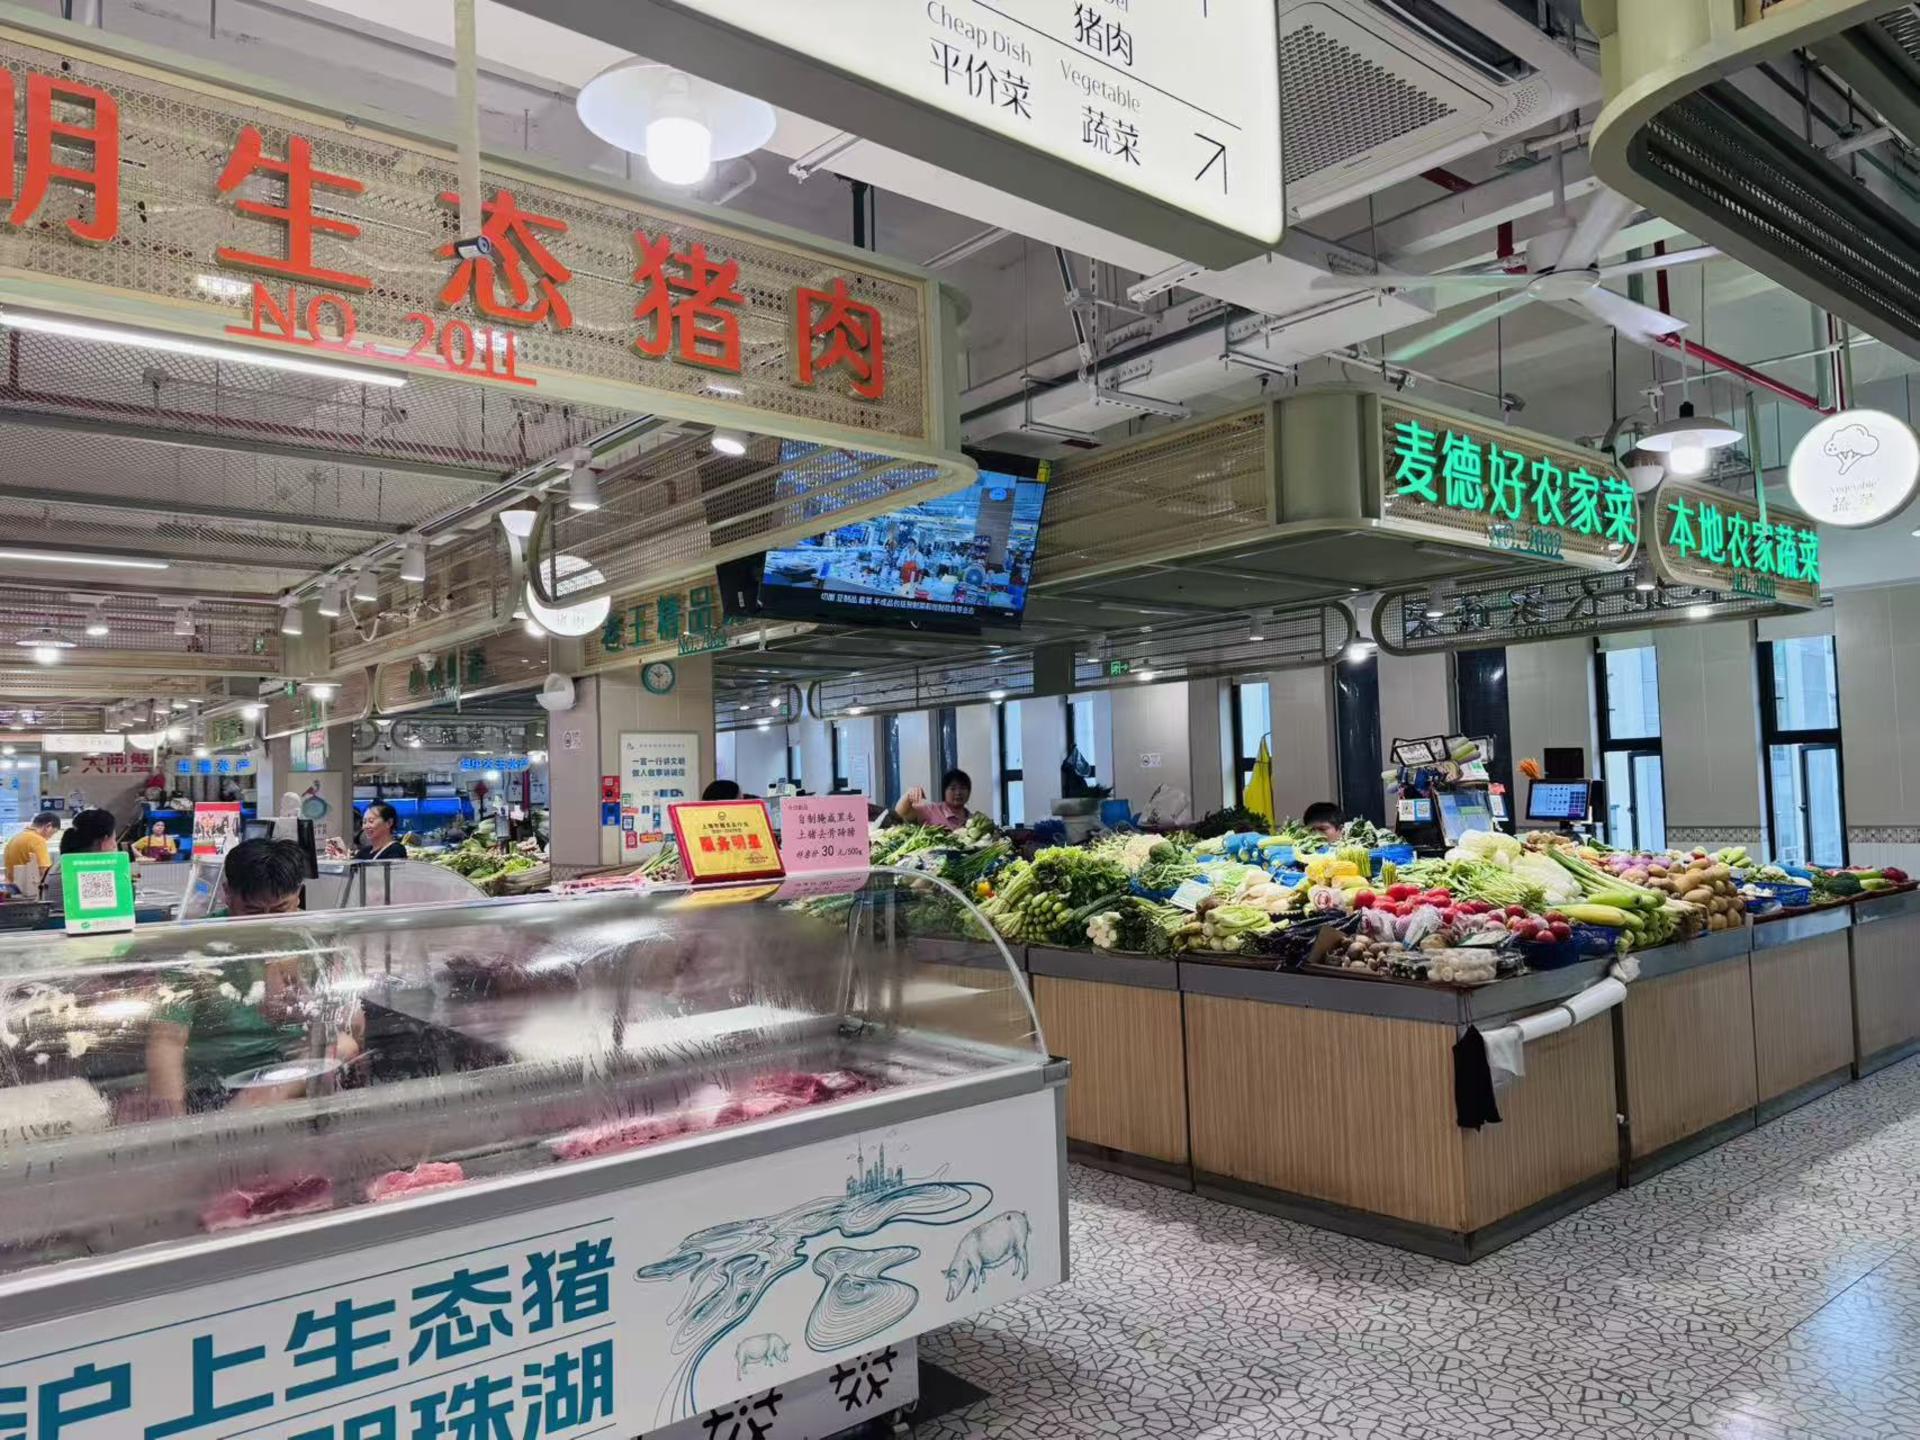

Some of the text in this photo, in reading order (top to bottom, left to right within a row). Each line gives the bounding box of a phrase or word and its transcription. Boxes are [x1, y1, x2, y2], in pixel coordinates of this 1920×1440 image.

[927, 1, 1032, 67] Cheap Dish
[1074, 3, 1133, 66] 猪肉
[930, 37, 1031, 120] 平价菜
[1060, 59, 1141, 113] Vegetable
[1081, 105, 1141, 166] 蔬菜
[1394, 420, 1638, 544] 麦德好农家菜
[1667, 496, 1822, 584] 本地农家蔬菜
[821, 845, 834, 857] 30
